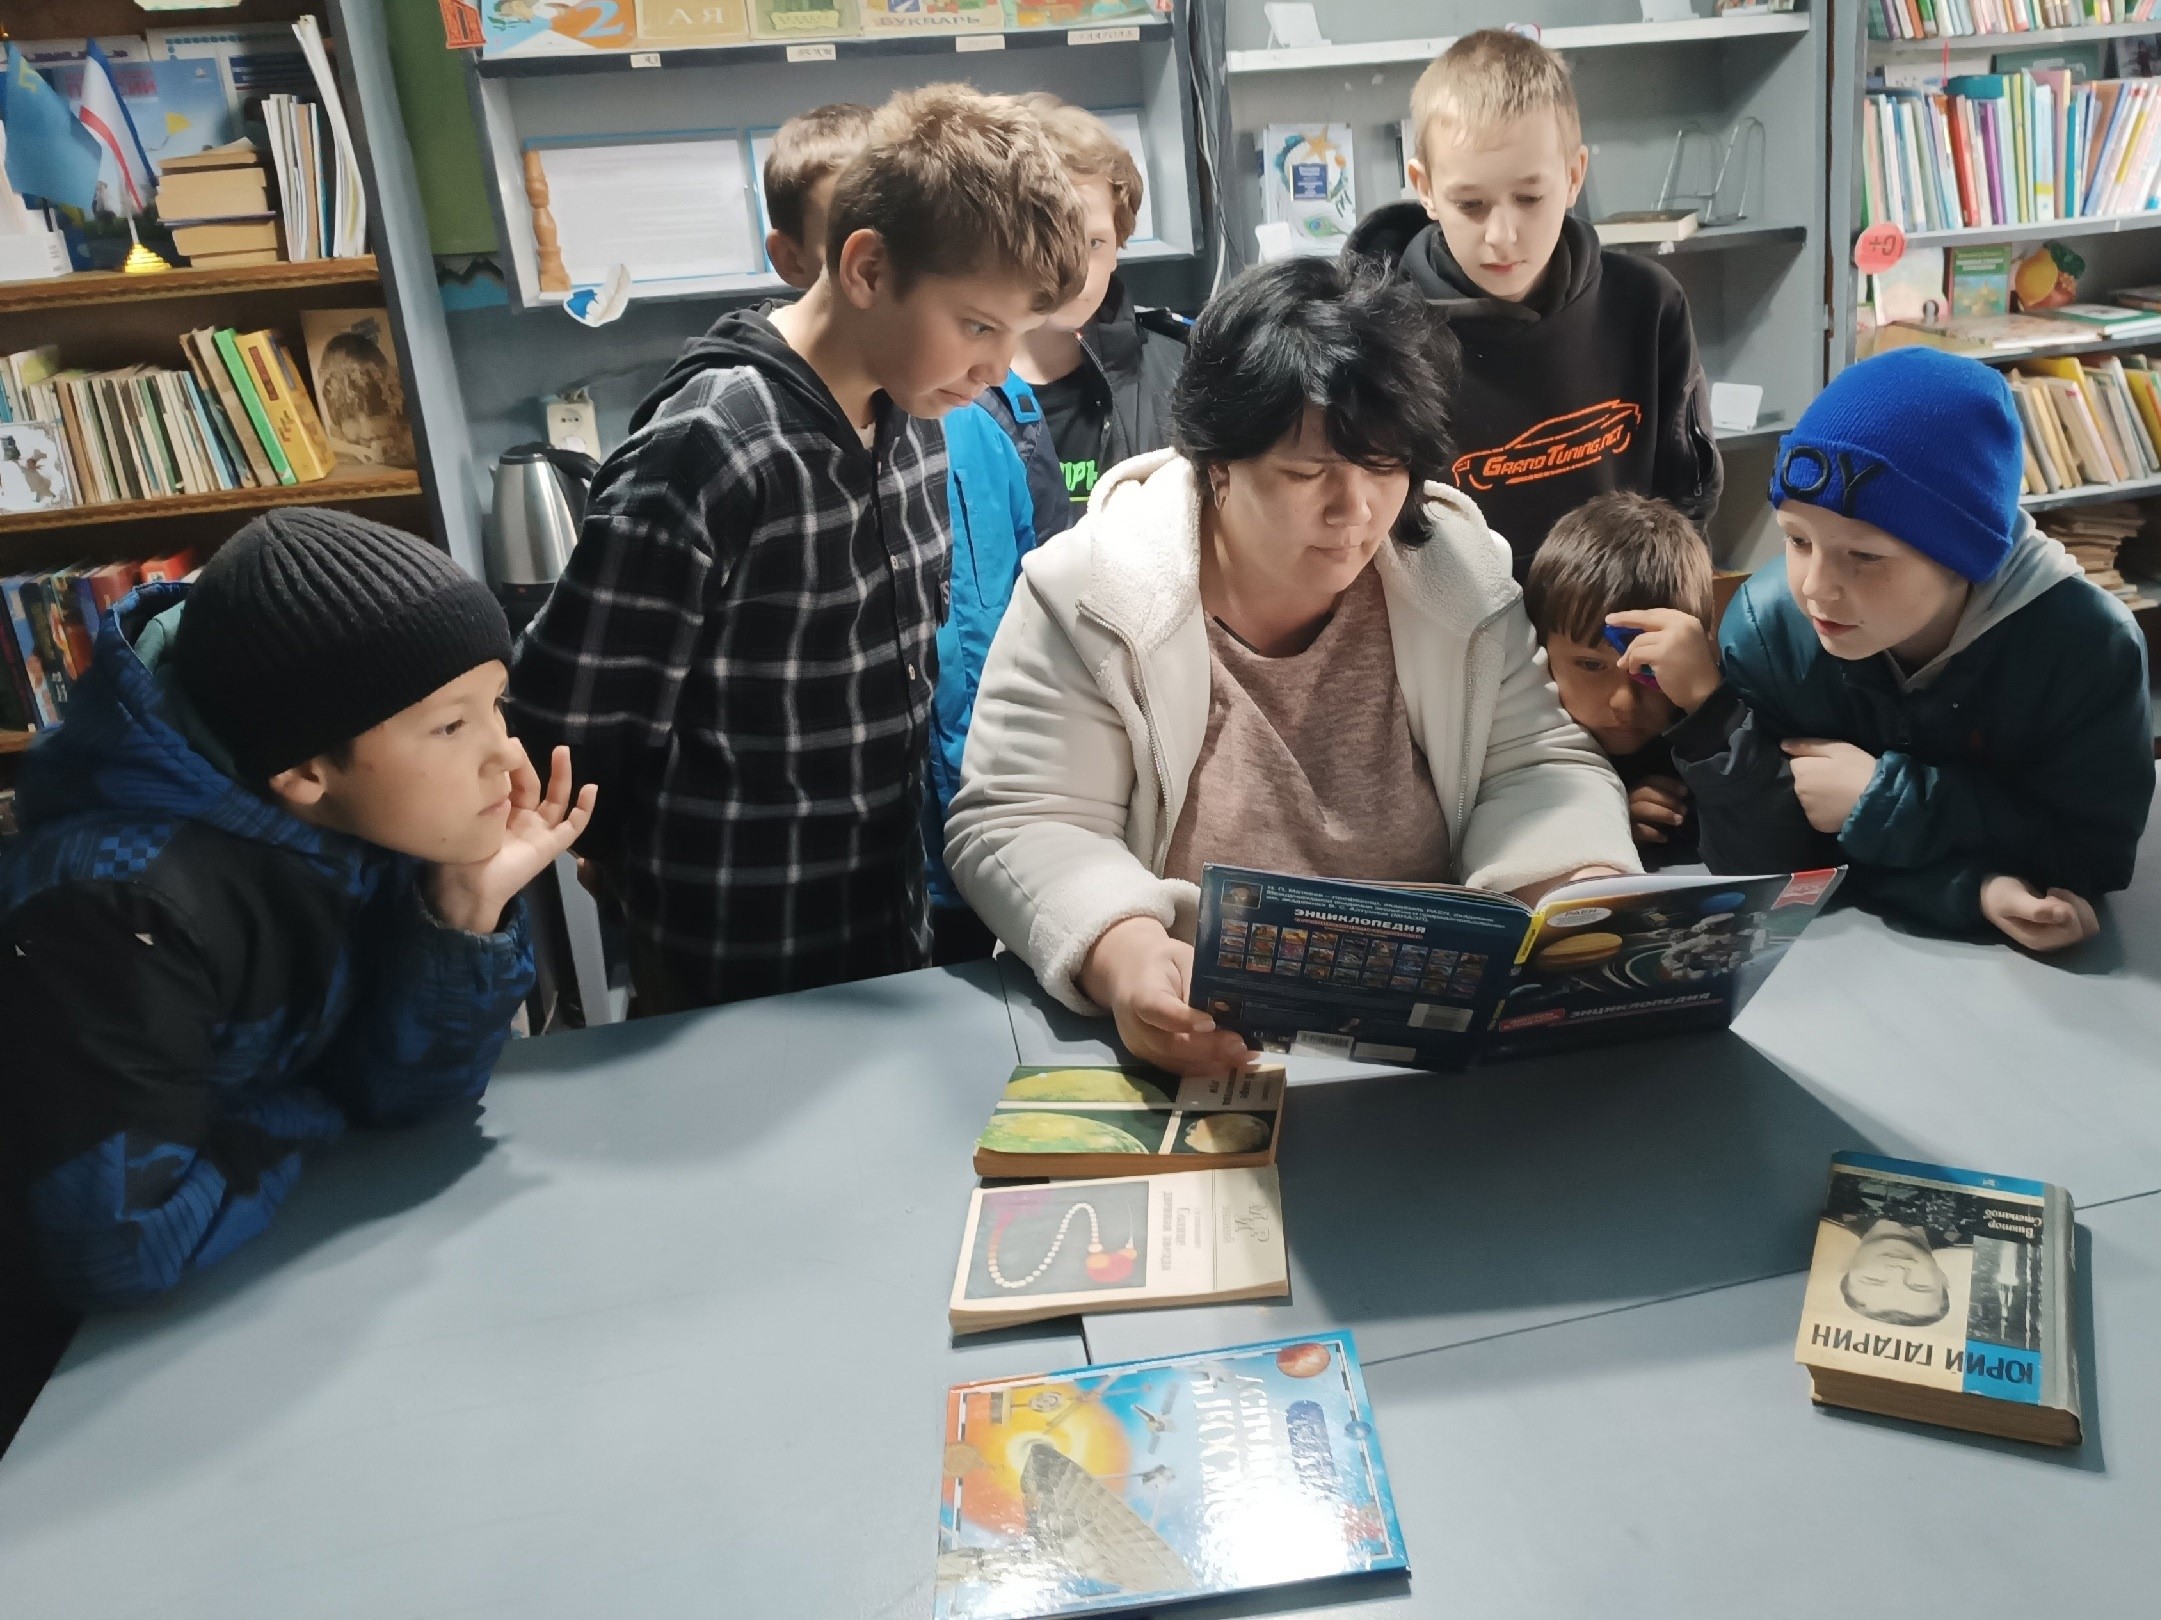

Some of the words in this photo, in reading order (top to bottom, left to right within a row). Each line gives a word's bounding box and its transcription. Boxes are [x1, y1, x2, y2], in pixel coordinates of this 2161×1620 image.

[879, 13, 980, 28] БУКВАРЬ
[1294, 908, 1426, 935] ЭНЦИКЛОПЕДИЯ
[1983, 1208, 2043, 1227] Степанов
[1987, 1219, 2034, 1239] Виктор
[1811, 1323, 1933, 1366] ГАГАРИН
[1945, 1348, 2034, 1386] ЮРИЙ
